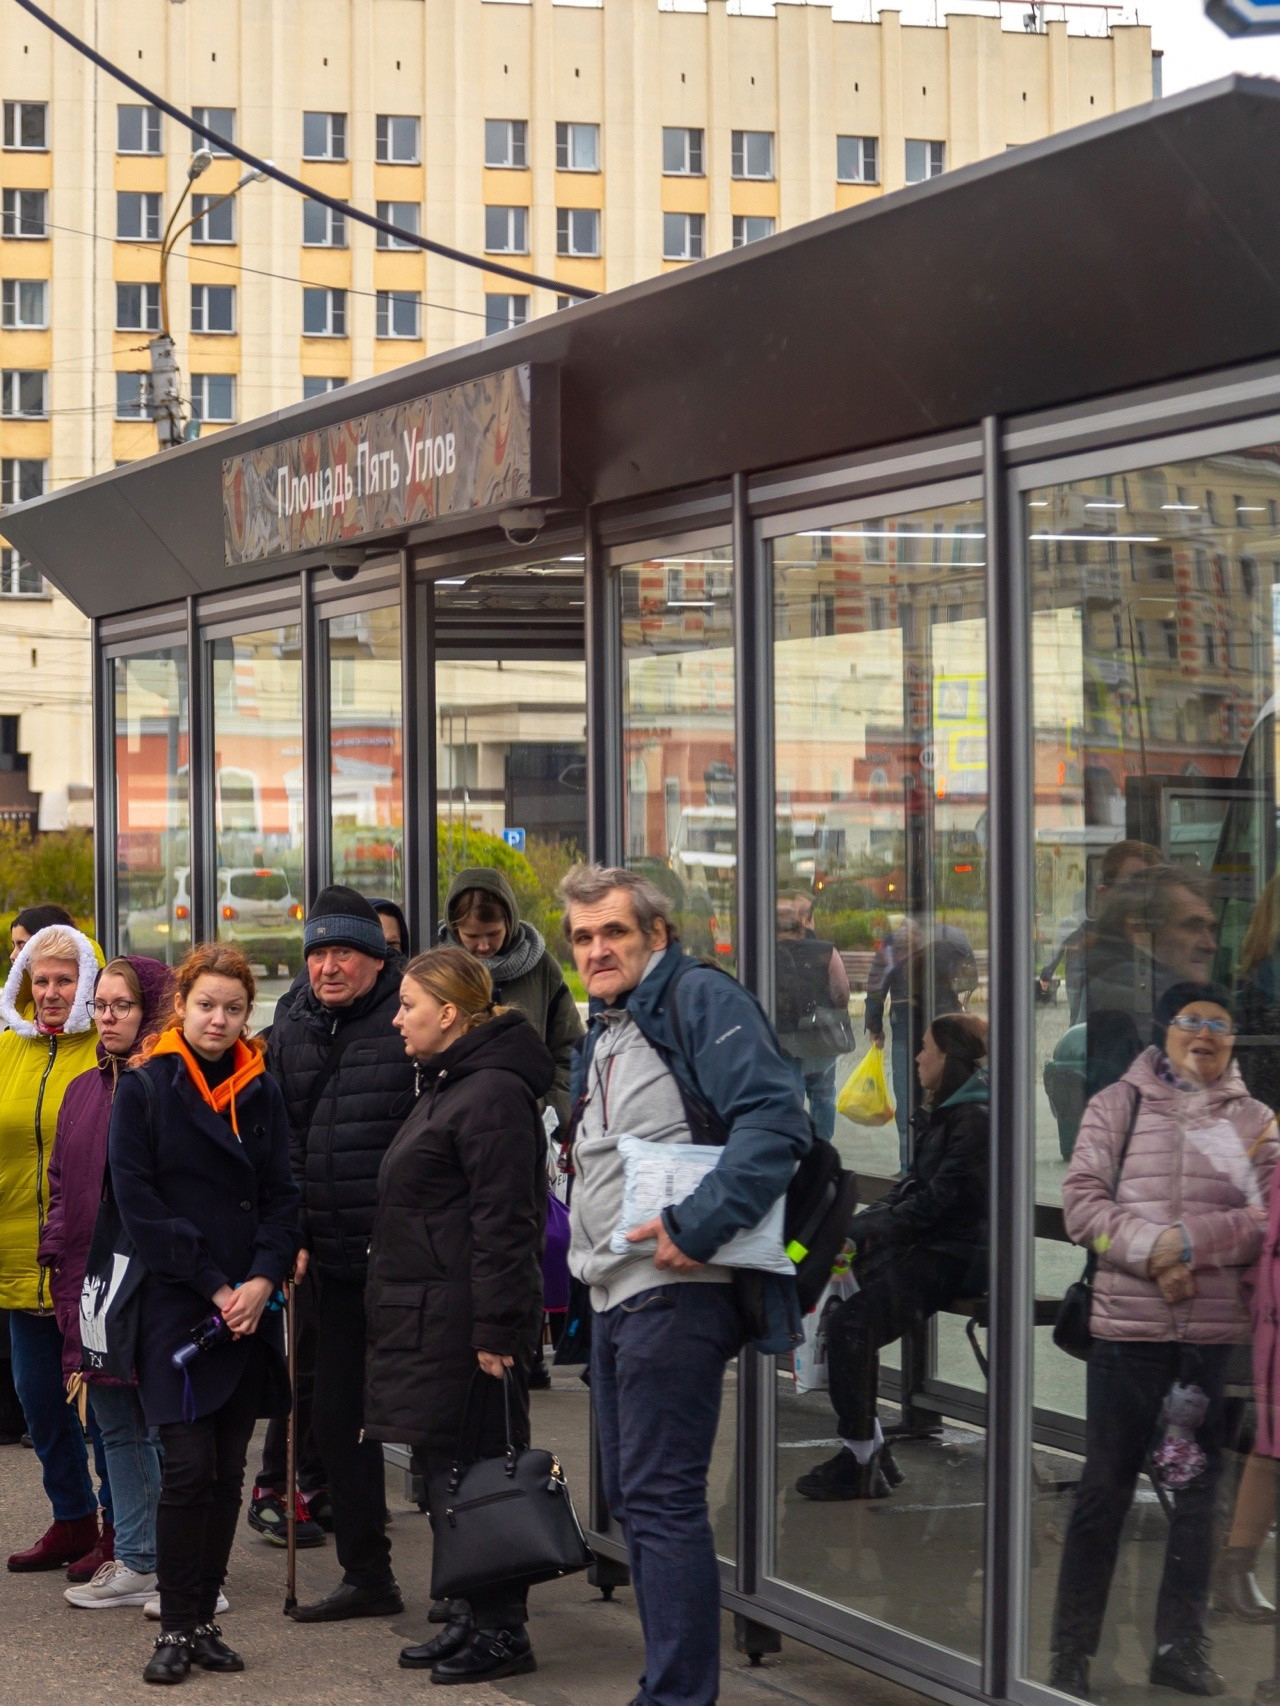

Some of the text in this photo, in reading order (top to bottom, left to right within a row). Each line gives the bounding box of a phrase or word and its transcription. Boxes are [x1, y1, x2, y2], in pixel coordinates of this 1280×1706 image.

[277, 427, 456, 518] Площадь Пять Углов
